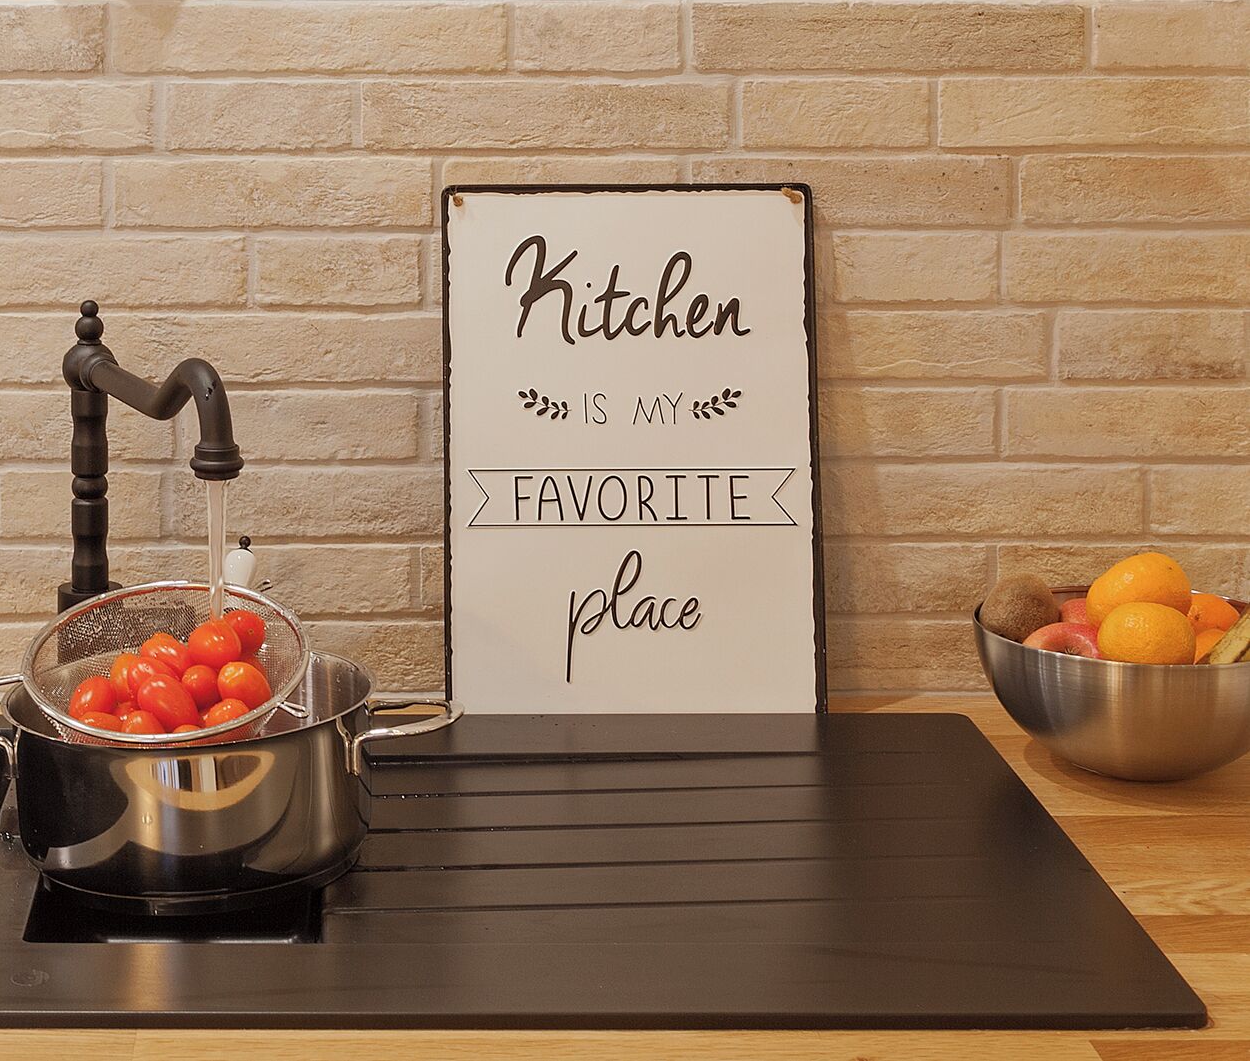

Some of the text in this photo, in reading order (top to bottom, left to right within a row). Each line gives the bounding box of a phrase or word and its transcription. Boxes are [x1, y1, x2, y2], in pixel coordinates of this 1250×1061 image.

[505, 235, 750, 345] Kitchen
[583, 393, 683, 425] IS MY
[514, 475, 751, 522] FAVORITE
[566, 550, 702, 683] place
